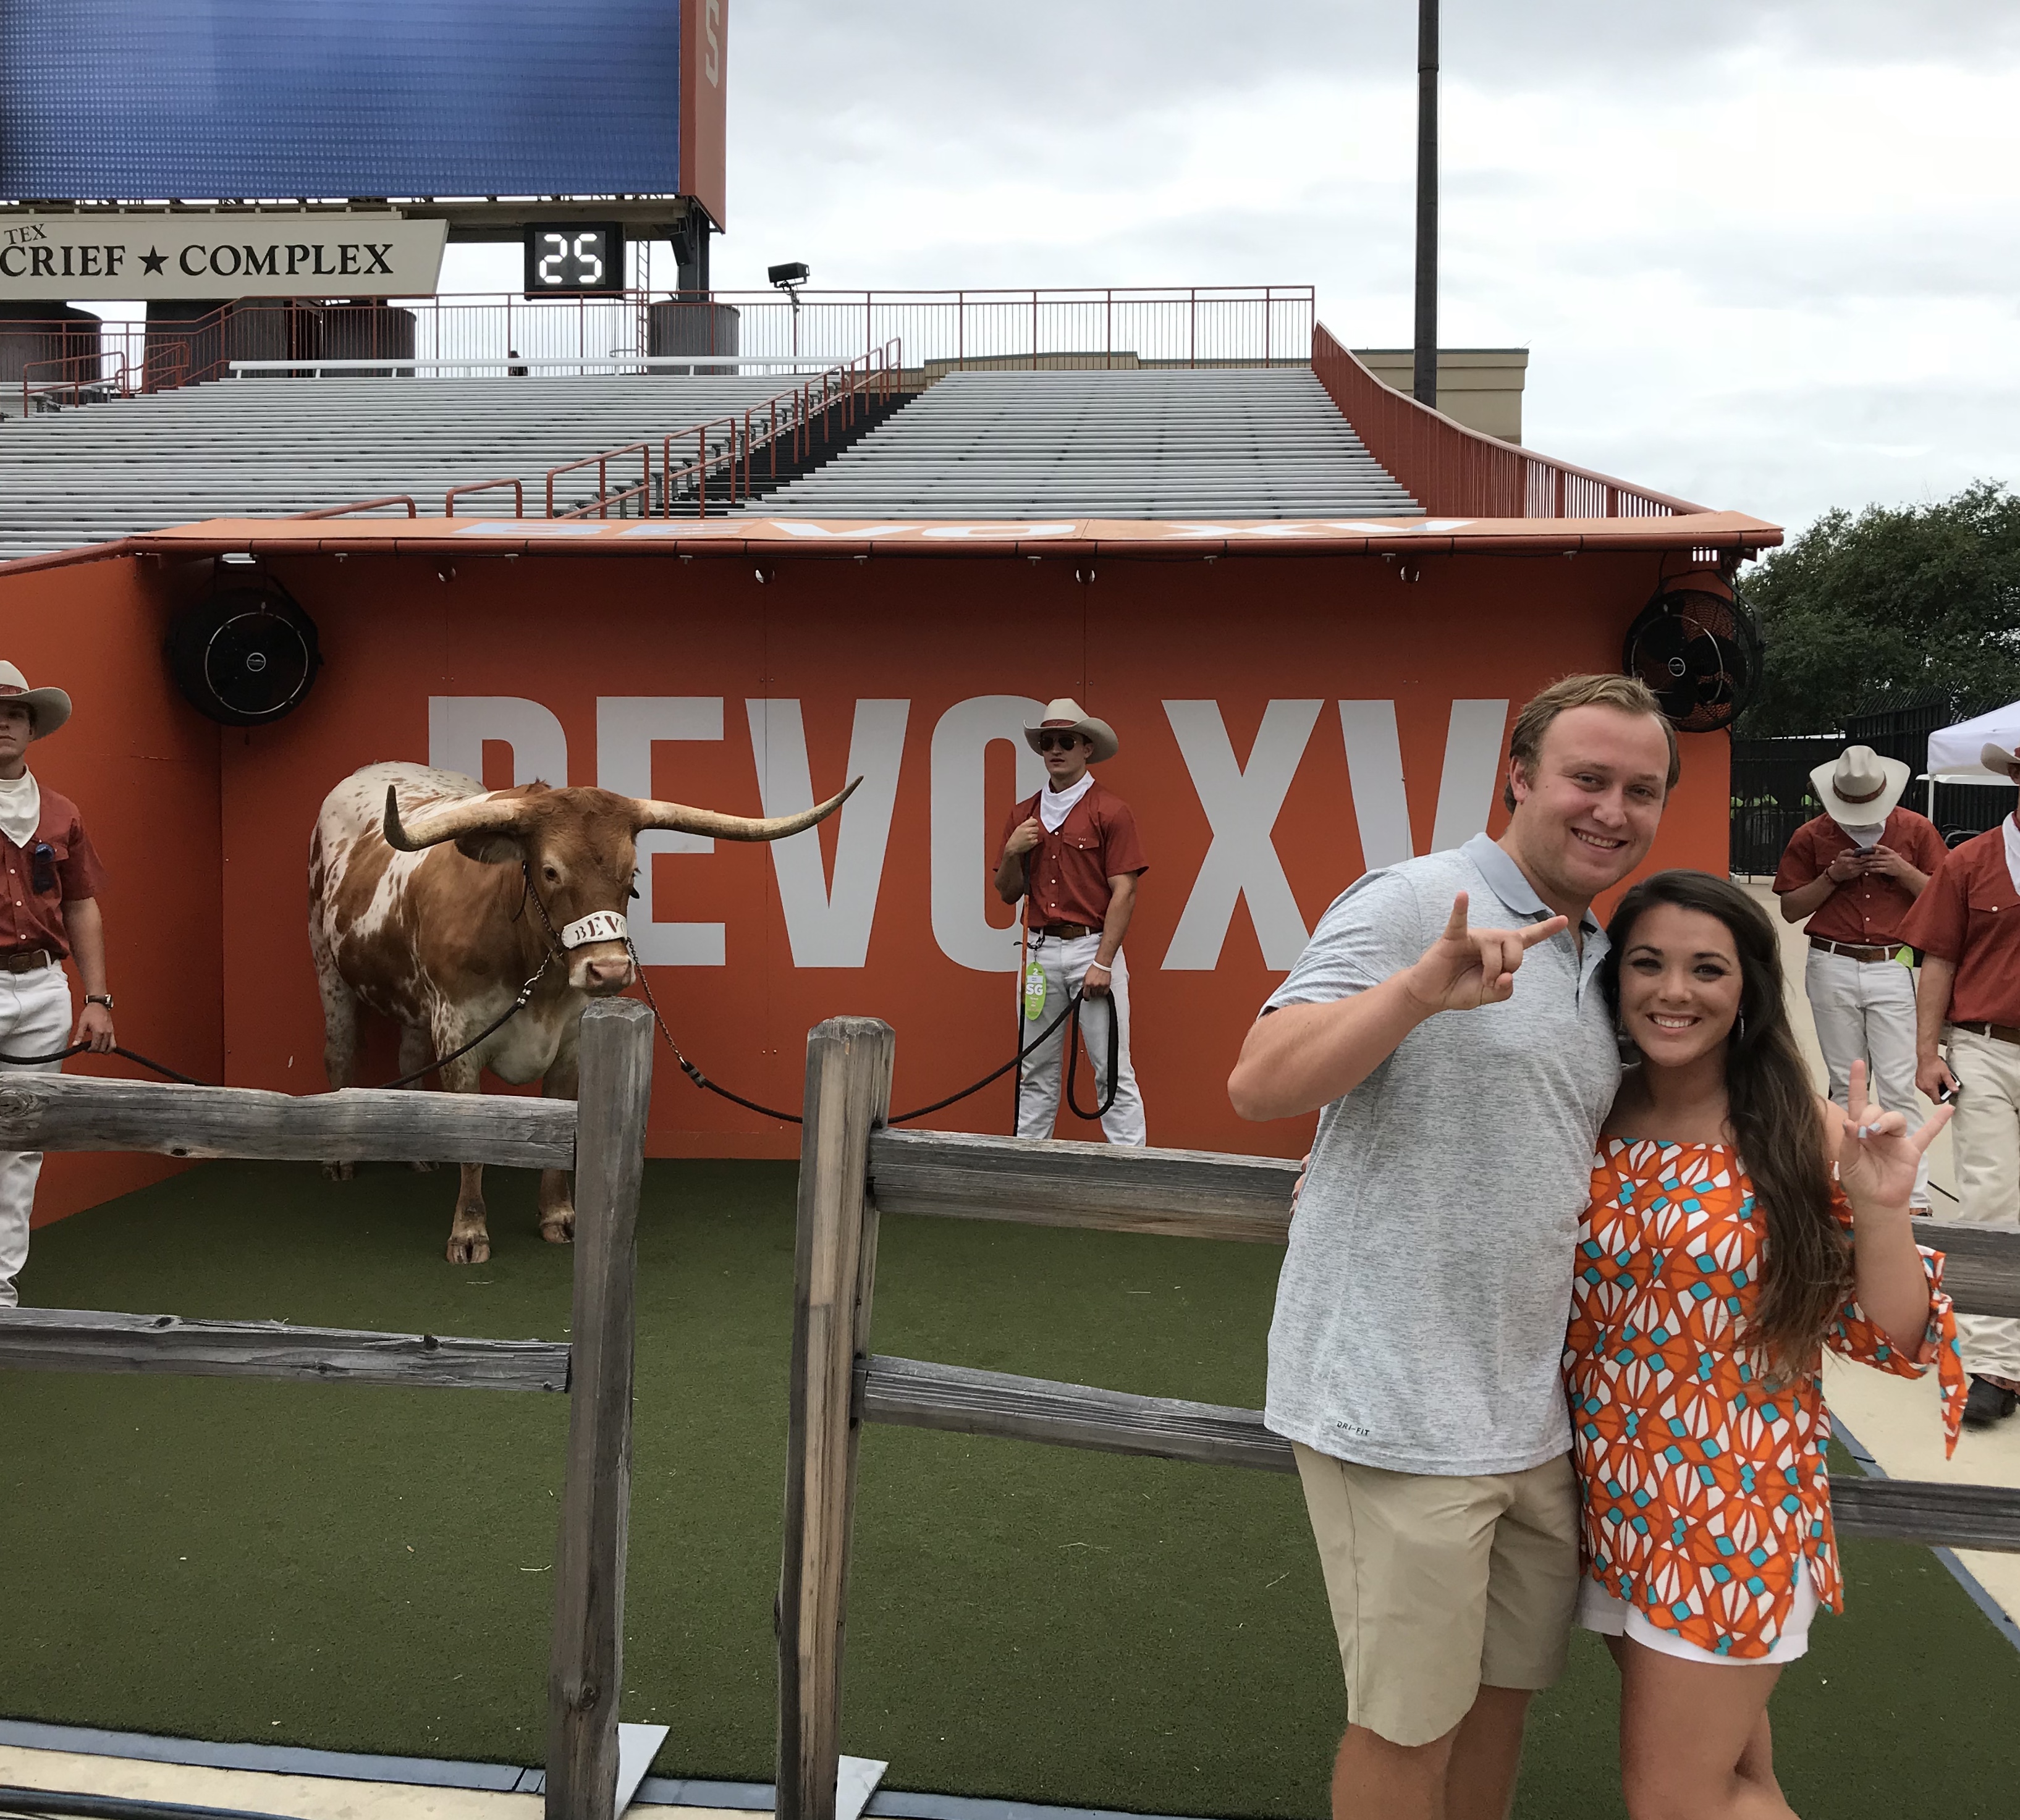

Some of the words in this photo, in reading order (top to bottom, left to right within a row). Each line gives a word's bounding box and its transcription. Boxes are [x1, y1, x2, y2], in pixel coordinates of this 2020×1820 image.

[4, 223, 47, 245] TEX
[0, 245, 125, 277] CRIEF
[179, 244, 394, 276] COMPLEX
[538, 232, 602, 284] 25
[1159, 520, 1480, 537] XV
[1033, 967, 1038, 975] 2
[1026, 984, 1044, 996] SG
[1337, 1420, 1370, 1436] DRI-FIT
